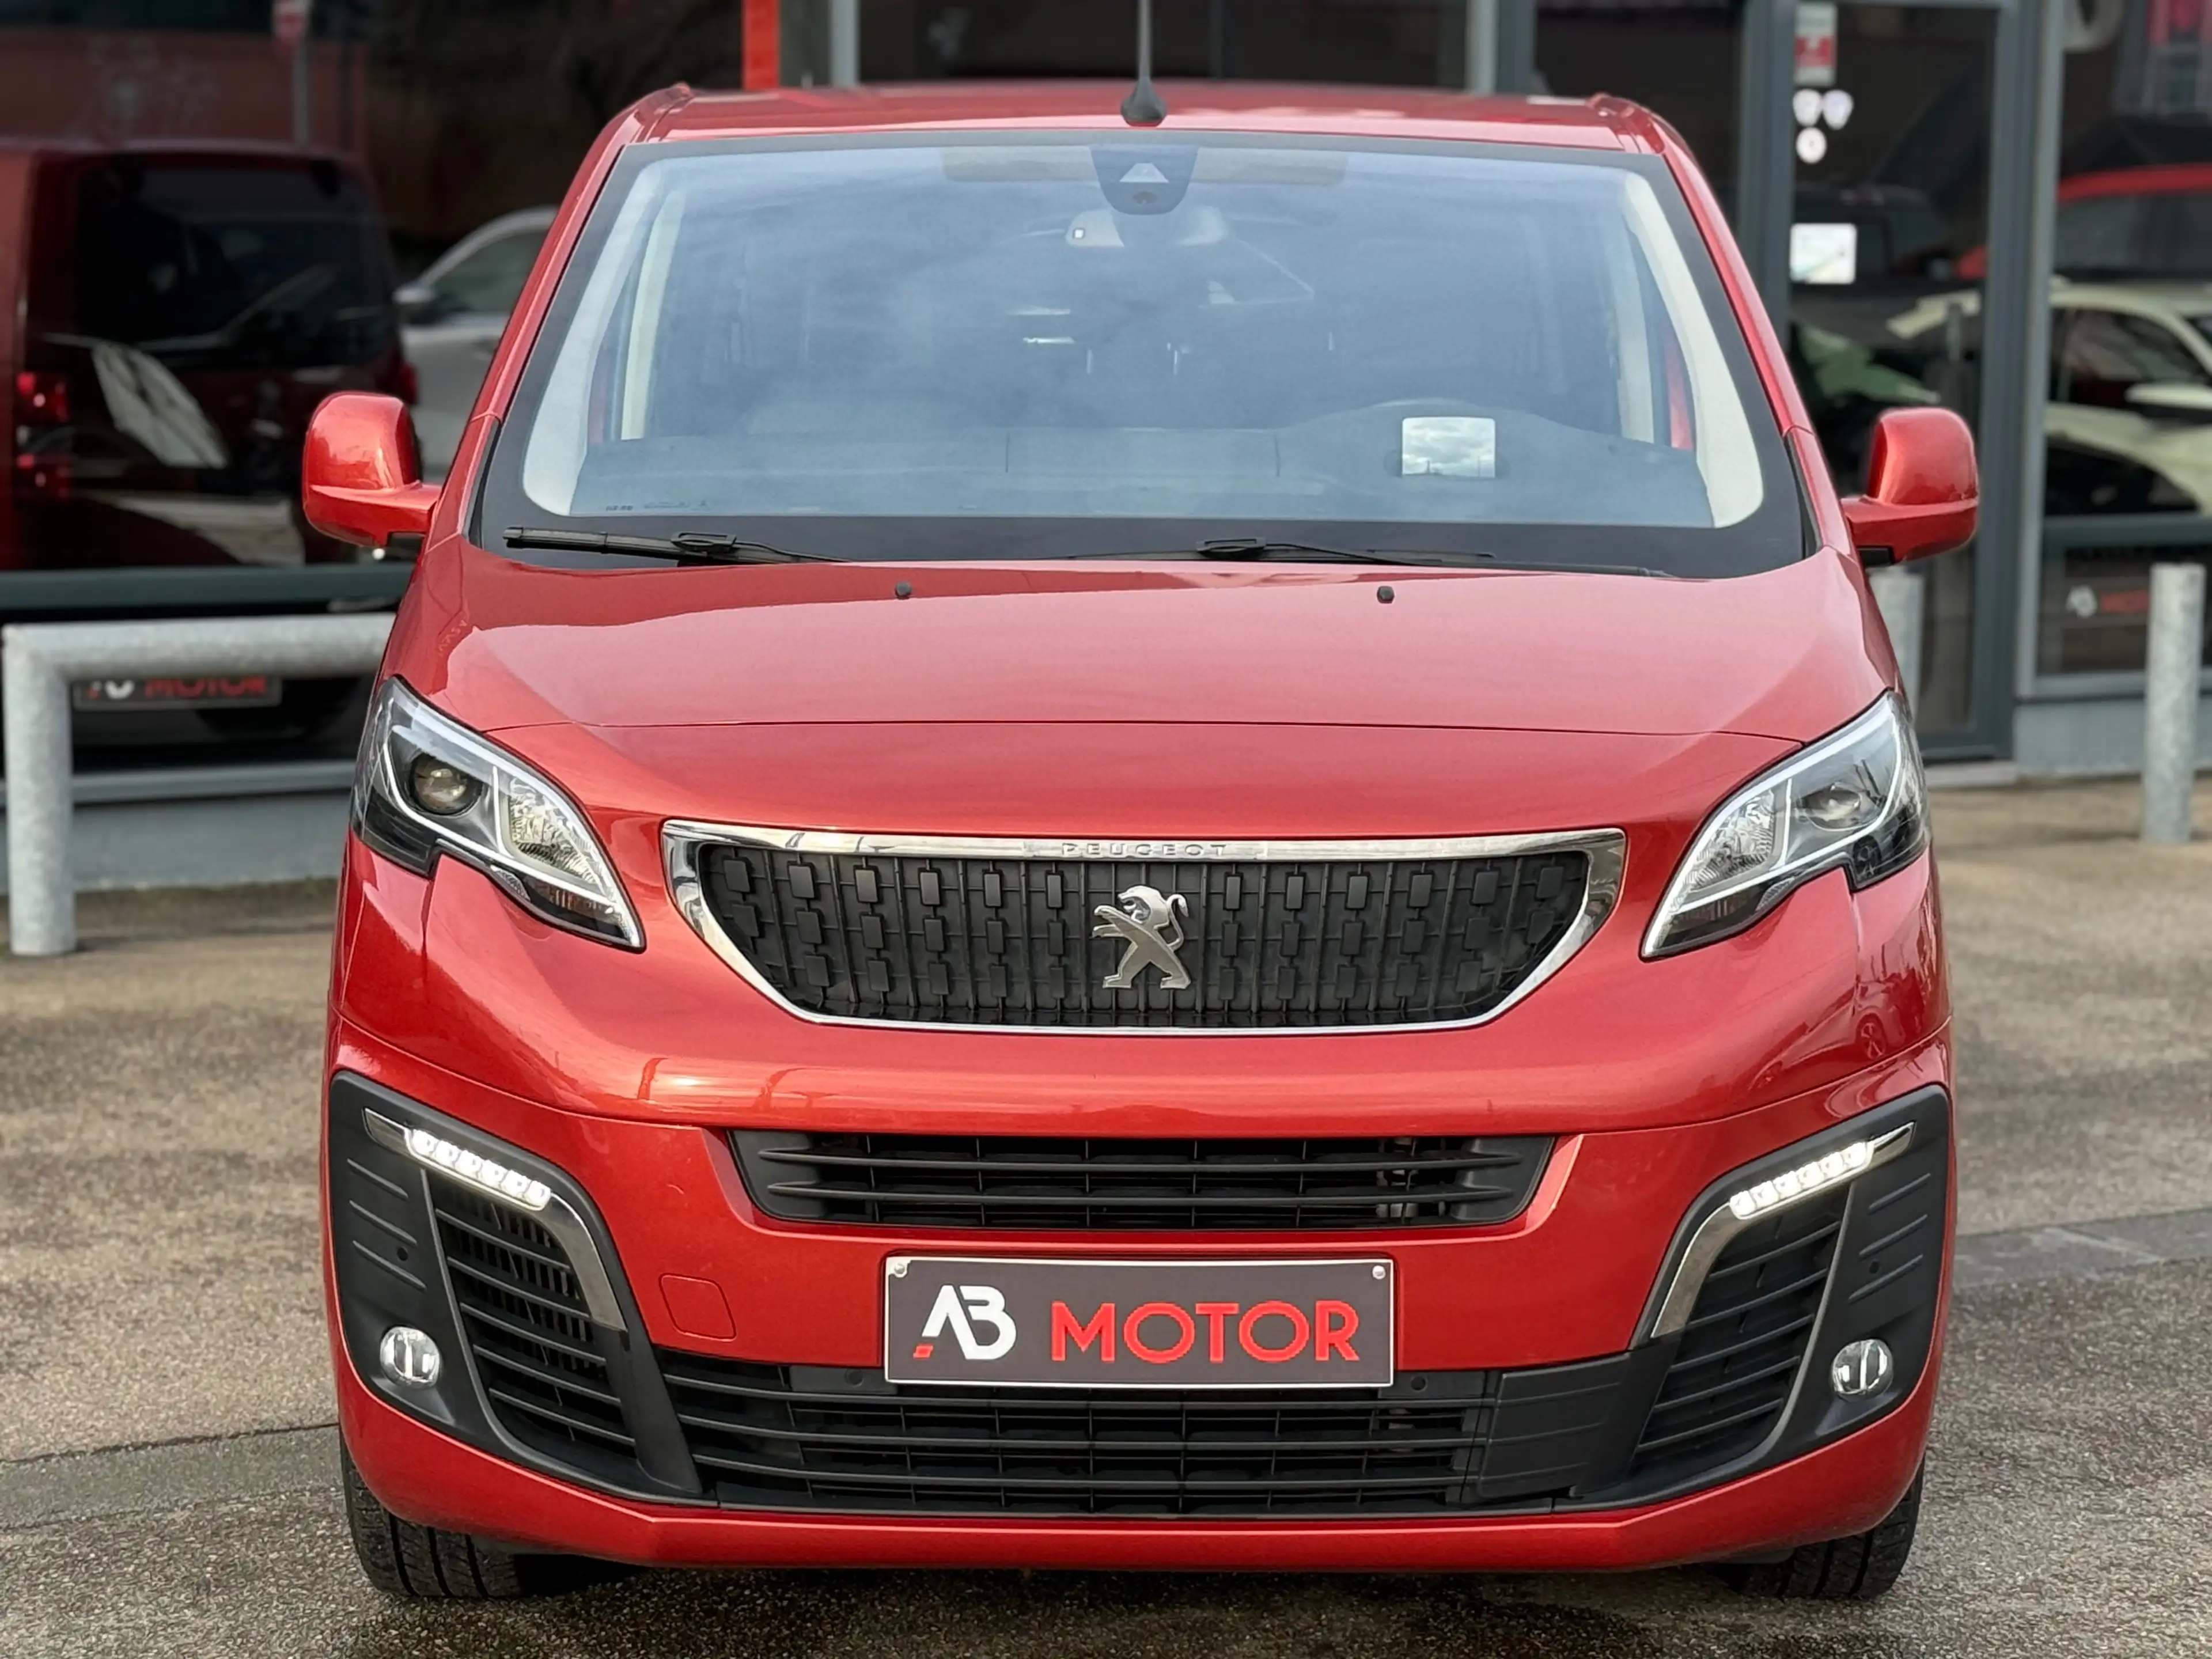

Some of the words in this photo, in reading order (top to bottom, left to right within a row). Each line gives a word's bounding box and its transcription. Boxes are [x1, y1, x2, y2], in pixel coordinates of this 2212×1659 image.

[1062, 842, 1227, 856] PEUGEOT
[913, 1285, 1016, 1360] AB
[1050, 1299, 1359, 1363] MOTOR
